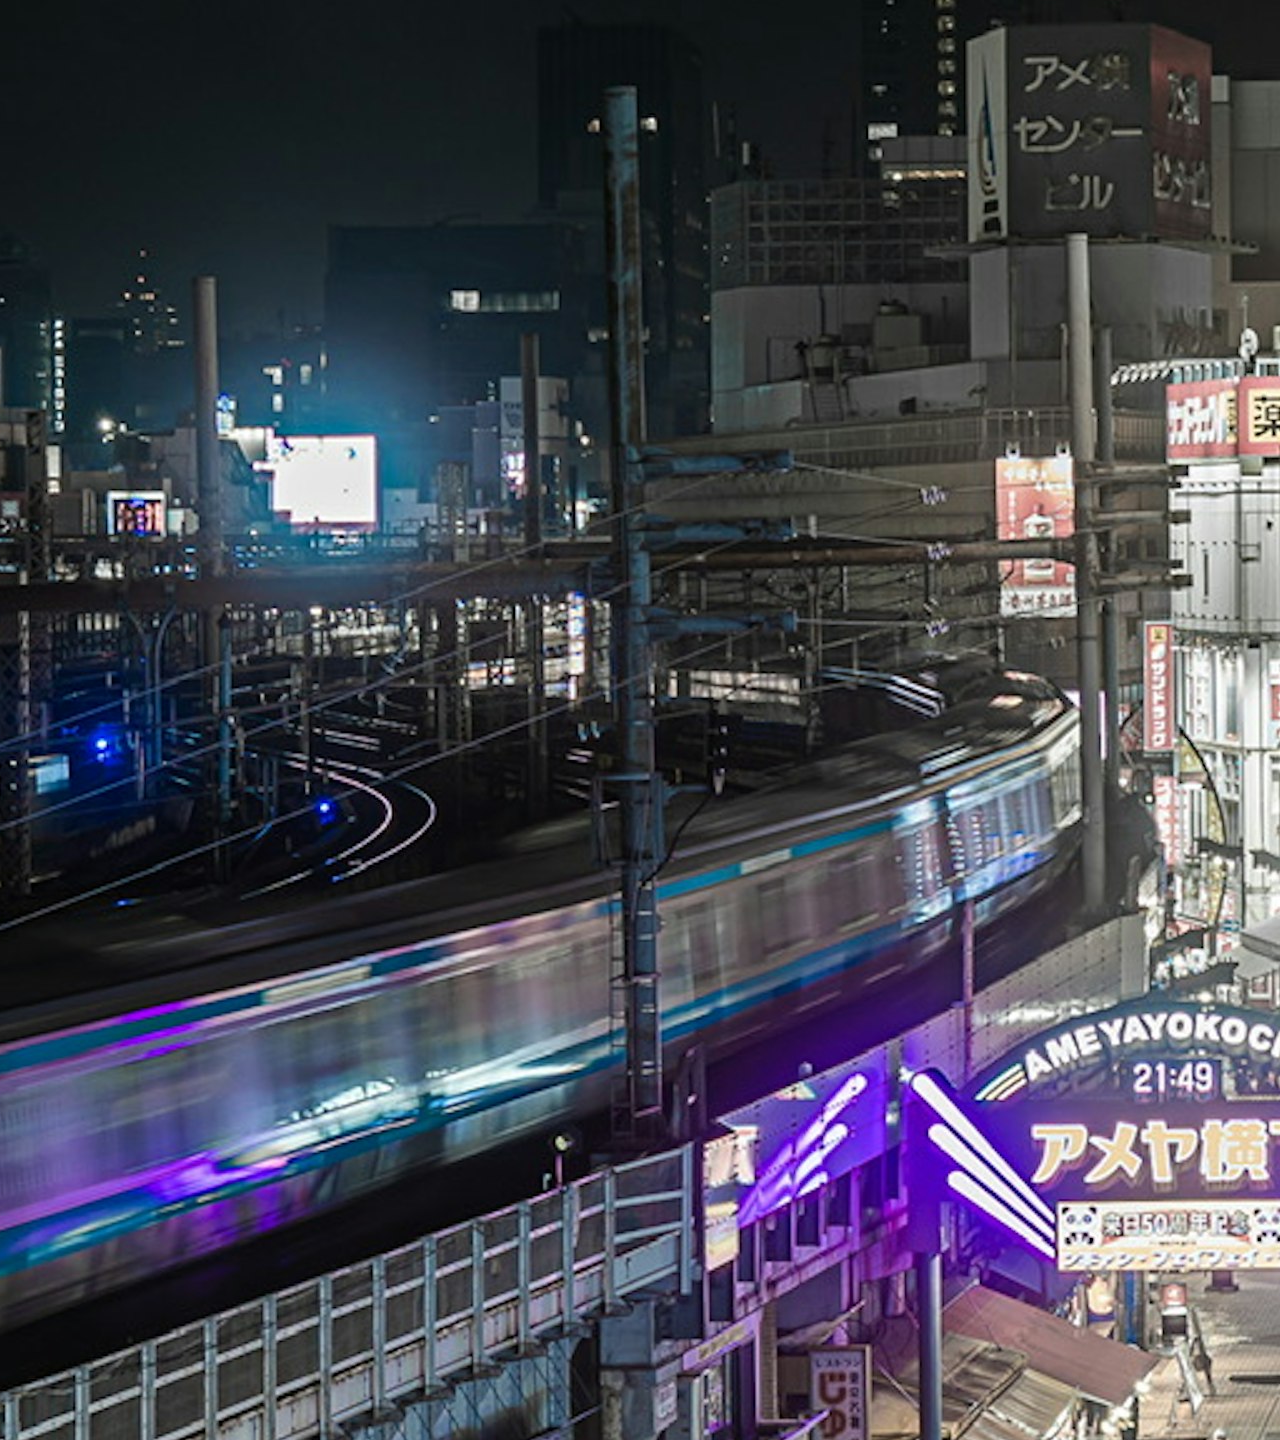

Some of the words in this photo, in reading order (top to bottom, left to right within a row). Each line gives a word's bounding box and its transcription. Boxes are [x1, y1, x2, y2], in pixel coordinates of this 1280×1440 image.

[1023, 53, 1132, 92] アメ横
[1013, 116, 1143, 153] センター
[1045, 173, 1114, 212] ビル
[1133, 1061, 1214, 1095] 21:49
